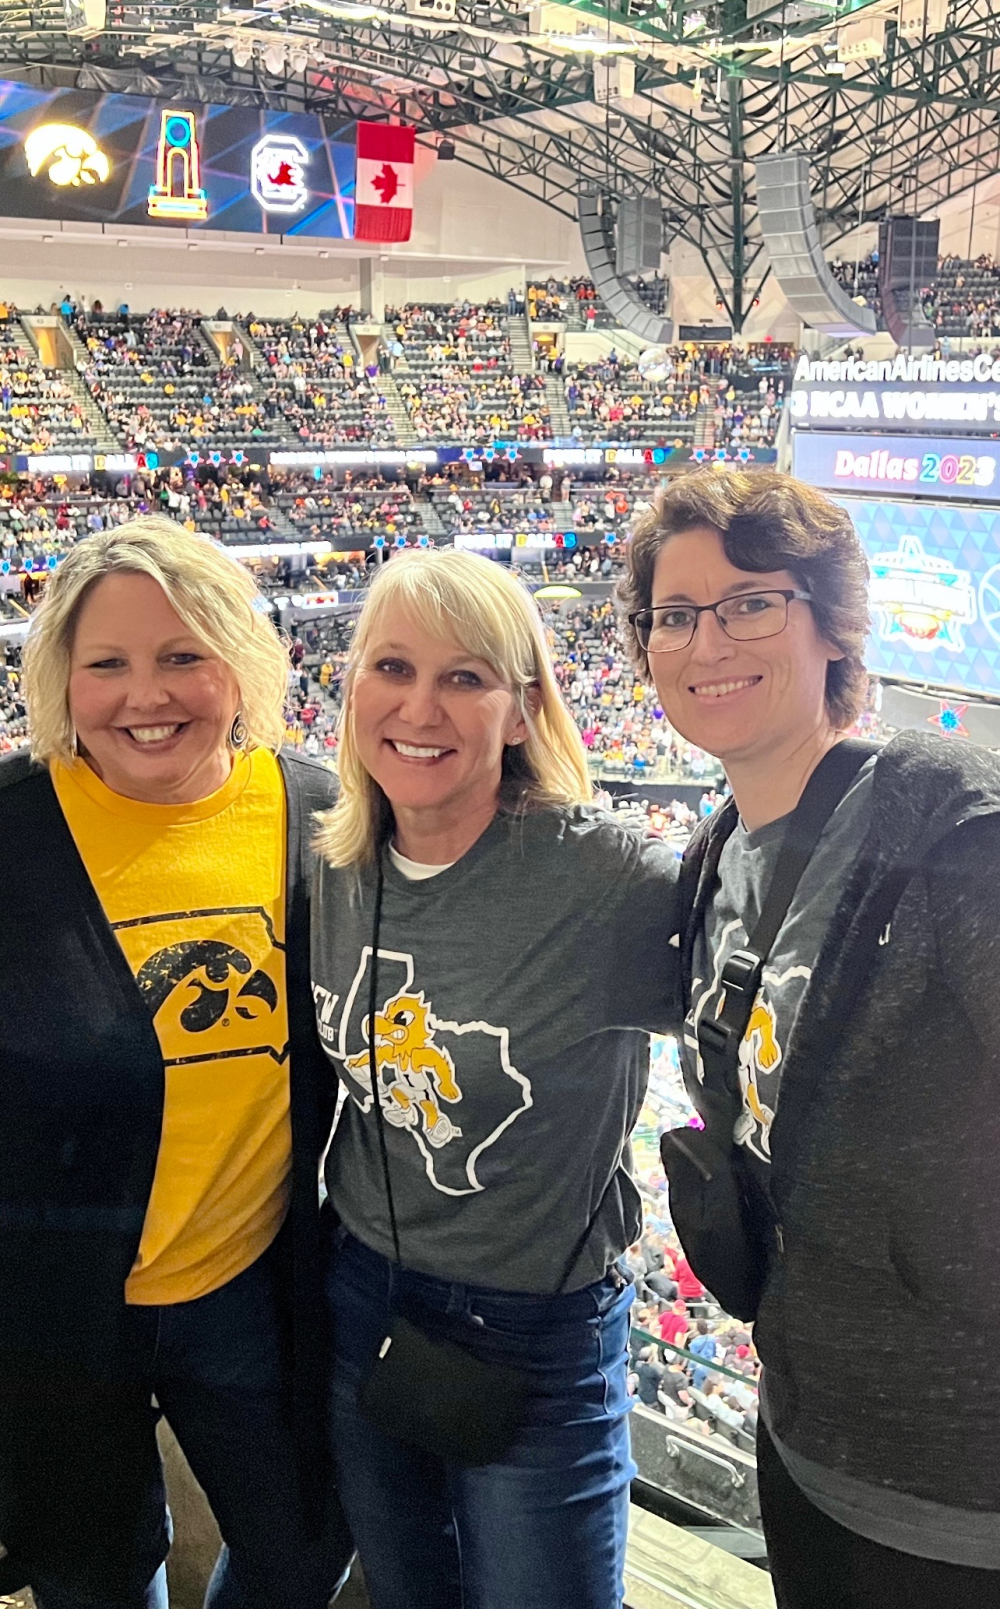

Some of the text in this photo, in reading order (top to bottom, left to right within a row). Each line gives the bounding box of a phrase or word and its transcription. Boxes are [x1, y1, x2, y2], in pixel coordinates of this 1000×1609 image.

[810, 391, 880, 418] NCAA
[834, 450, 997, 486] Dallas 2023
[311, 981, 339, 1024] FW
